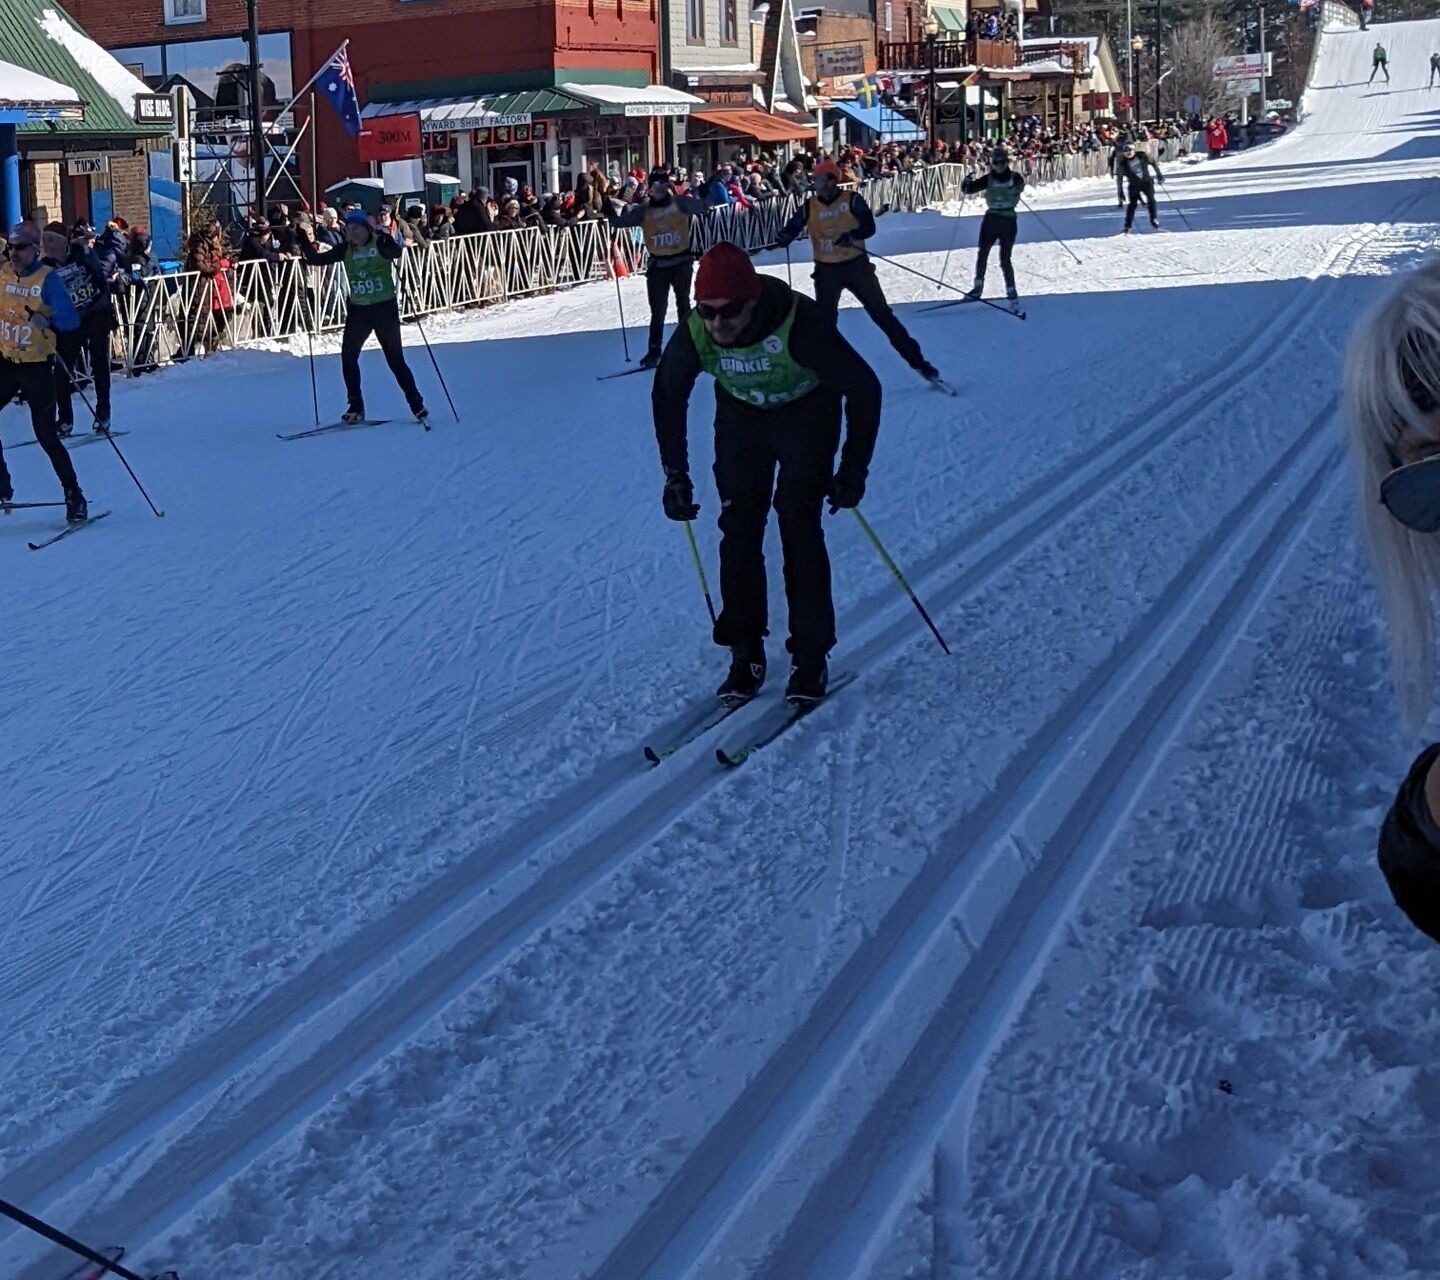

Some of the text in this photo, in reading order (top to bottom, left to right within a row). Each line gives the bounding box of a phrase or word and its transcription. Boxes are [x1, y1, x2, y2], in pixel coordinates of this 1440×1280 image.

[422, 114, 529, 133] AYWARD SHIRT FACTORY
[721, 357, 771, 374] BIRKIE
